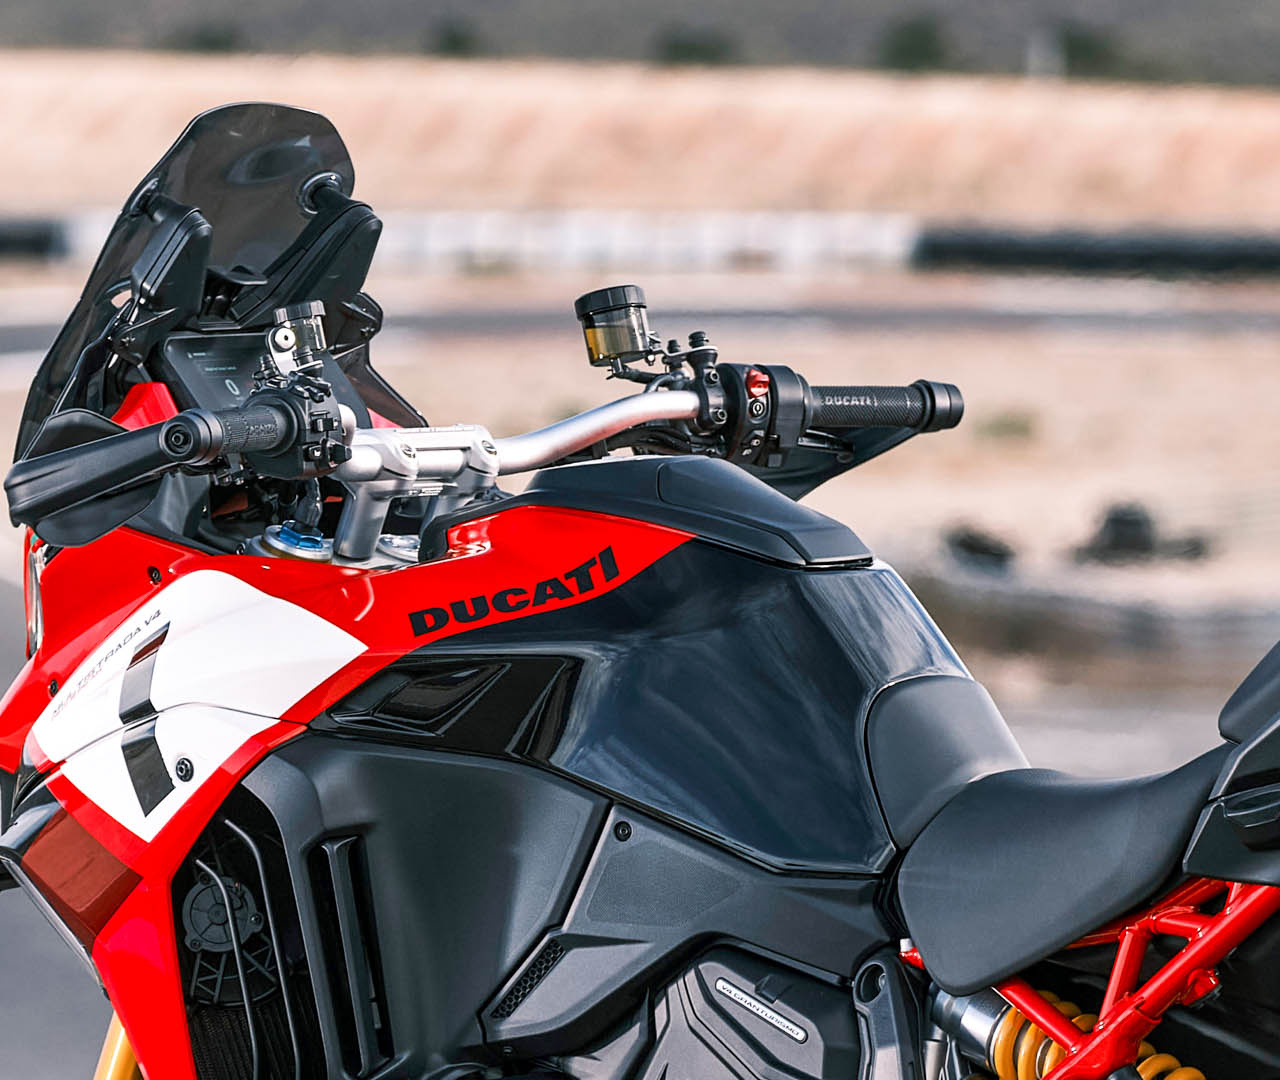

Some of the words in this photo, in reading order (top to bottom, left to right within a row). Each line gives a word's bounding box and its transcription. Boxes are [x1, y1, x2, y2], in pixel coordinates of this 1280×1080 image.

[225, 379, 240, 396] 0
[825, 395, 873, 406] DUCATI
[408, 545, 620, 637] DUCATI
[144, 609, 161, 626] V4
[721, 984, 732, 995] V4
[733, 992, 800, 1037] GRANTURISMO
